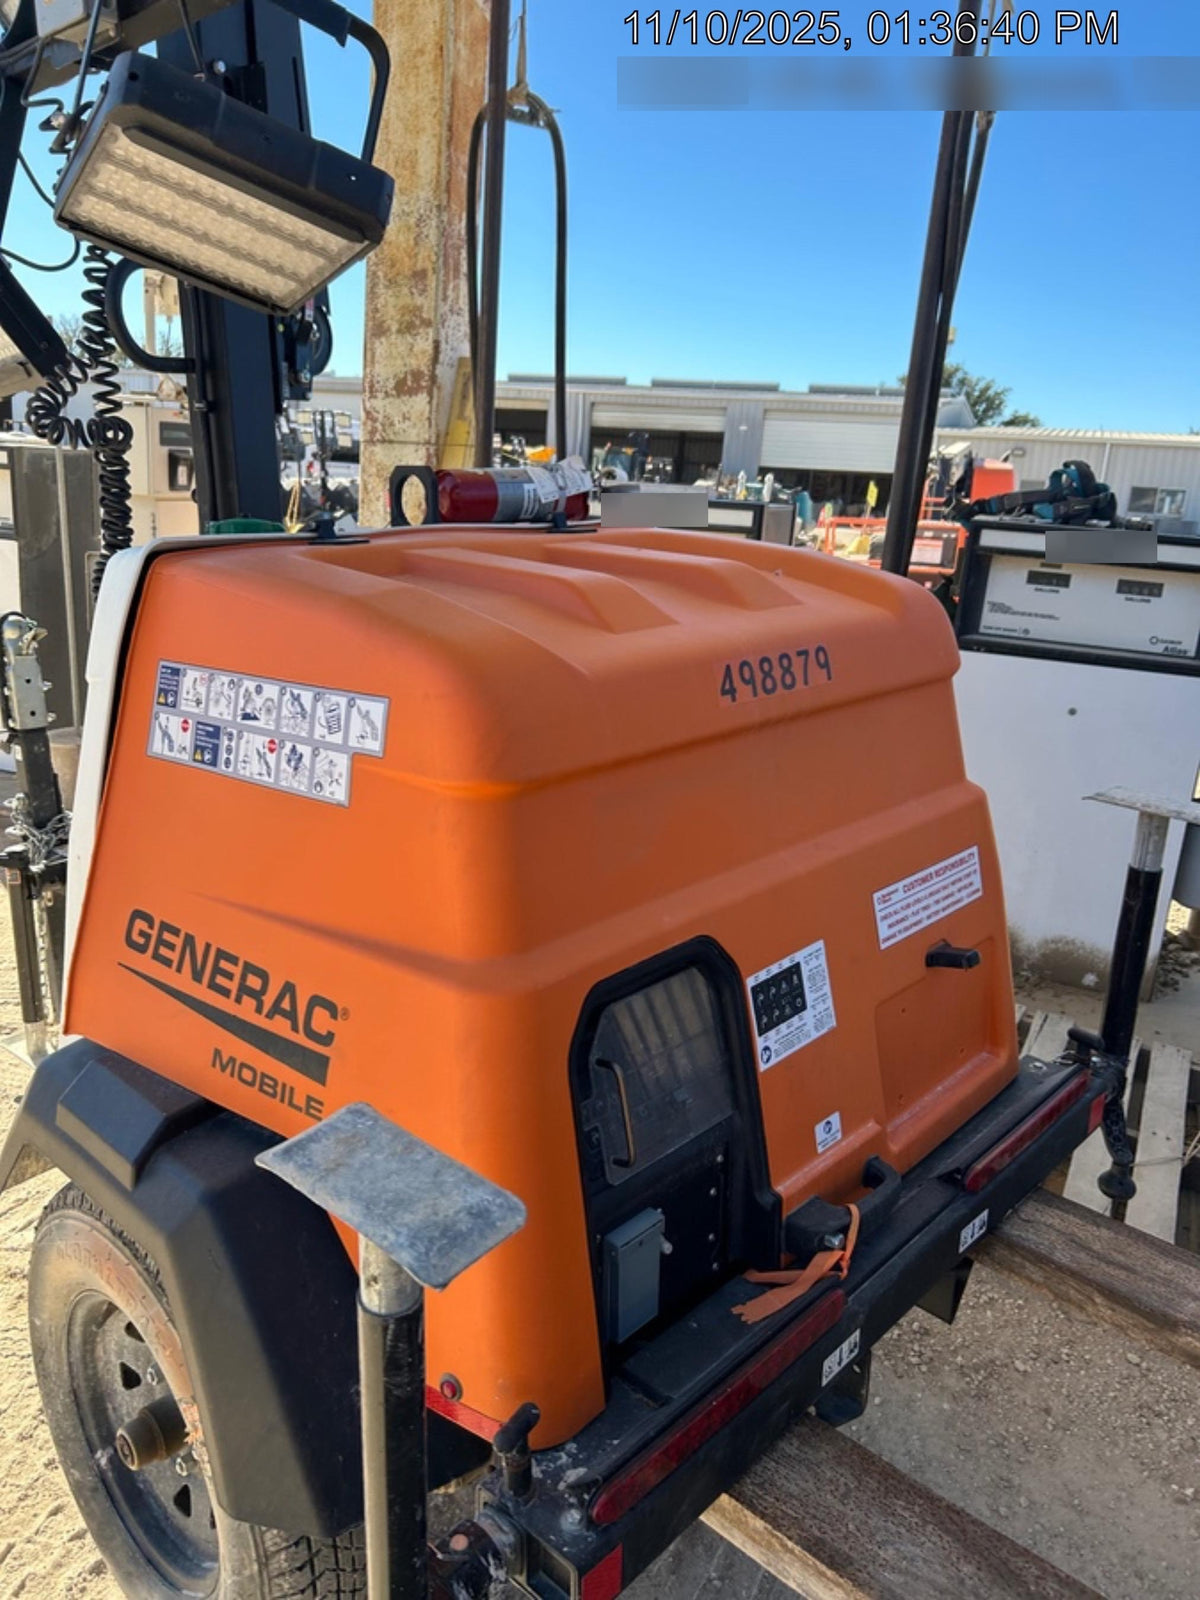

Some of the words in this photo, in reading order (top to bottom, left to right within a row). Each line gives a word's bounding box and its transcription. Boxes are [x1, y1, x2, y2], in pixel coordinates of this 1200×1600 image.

[720, 645, 832, 702] 498879
[124, 908, 339, 1048] GENERAC
[211, 1047, 324, 1121] MOBILE
